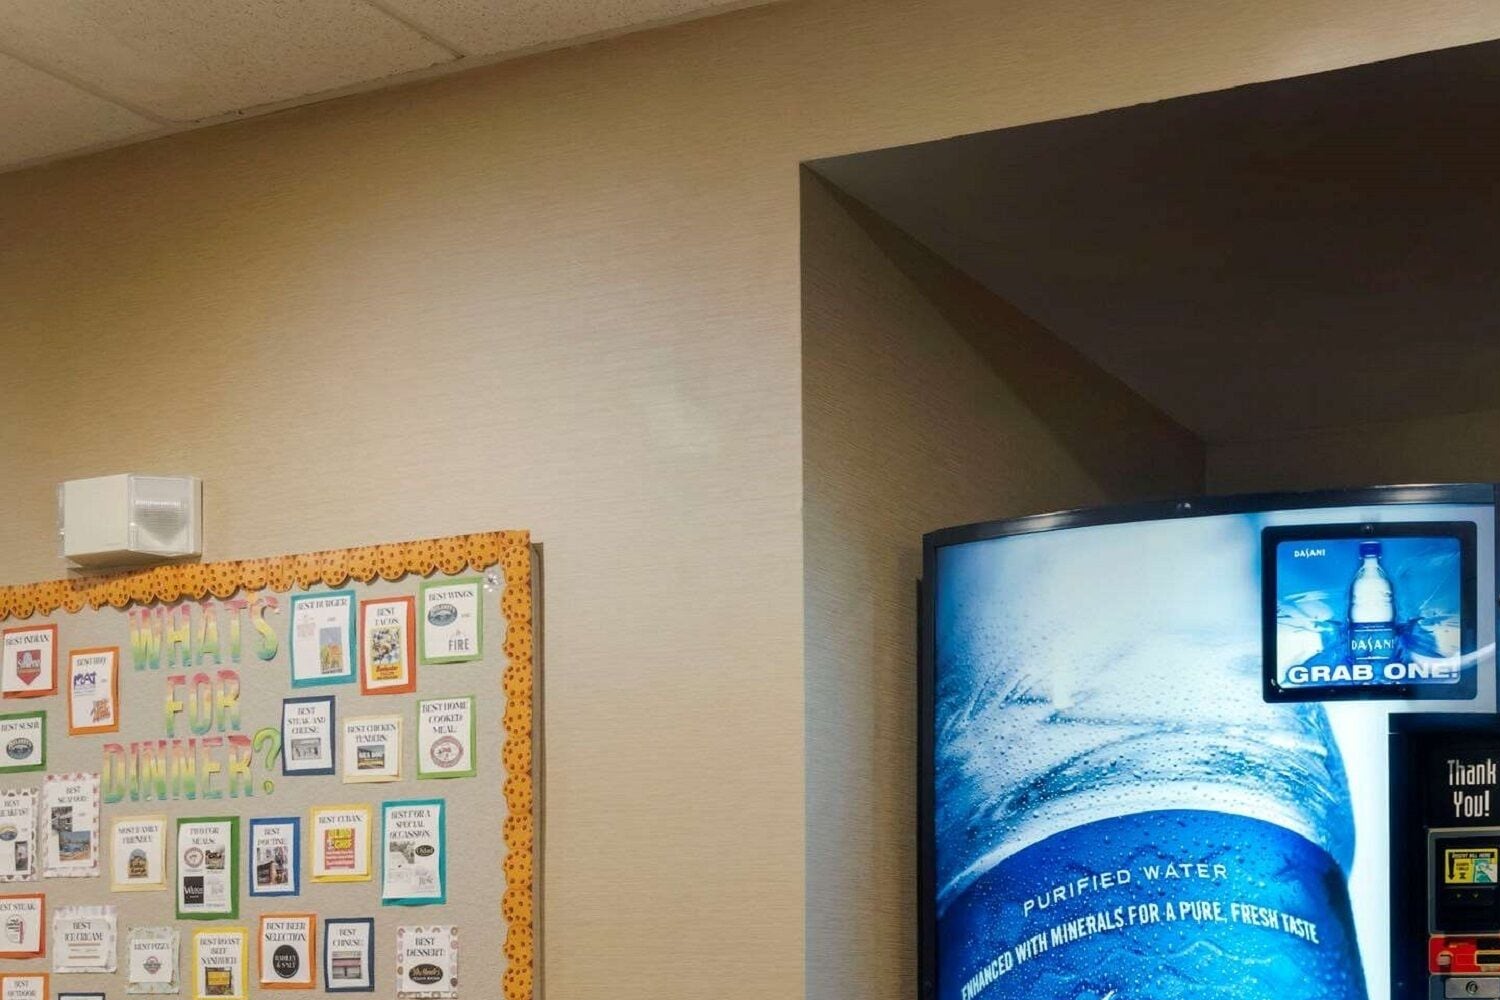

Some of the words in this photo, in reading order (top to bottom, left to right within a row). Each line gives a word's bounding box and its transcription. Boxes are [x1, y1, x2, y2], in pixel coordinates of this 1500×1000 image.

[1294, 548, 1326, 558] DASANI
[377, 608, 395, 616] BEST
[448, 639, 470, 651] FIRE
[1351, 636, 1394, 652] DASANI
[1288, 664, 1374, 684] GRAB
[1383, 662, 1459, 680] ONE!
[166, 669, 241, 737] FOR
[422, 704, 442, 713] BEST
[443, 701, 467, 710] HOME
[428, 714, 463, 723] COOKED
[347, 725, 365, 733] BEST
[366, 724, 396, 732] CHICKEN
[1447, 758, 1497, 786] Thank
[1453, 790, 1490, 817] You!
[319, 816, 336, 824] BEST
[1023, 869, 1130, 917] PURIFIED
[1143, 863, 1228, 881] WATER
[286, 922, 306, 930] BEER
[1015, 933, 1049, 962] WITH
[1051, 907, 1124, 948] MINERALS
[1129, 903, 1160, 924] FOR
[1166, 902, 1177, 921] A
[1231, 901, 1280, 925] FRESH
[1282, 912, 1320, 945] TASTE
[265, 933, 306, 941] SELECTION
[406, 949, 443, 957] DESSERT
